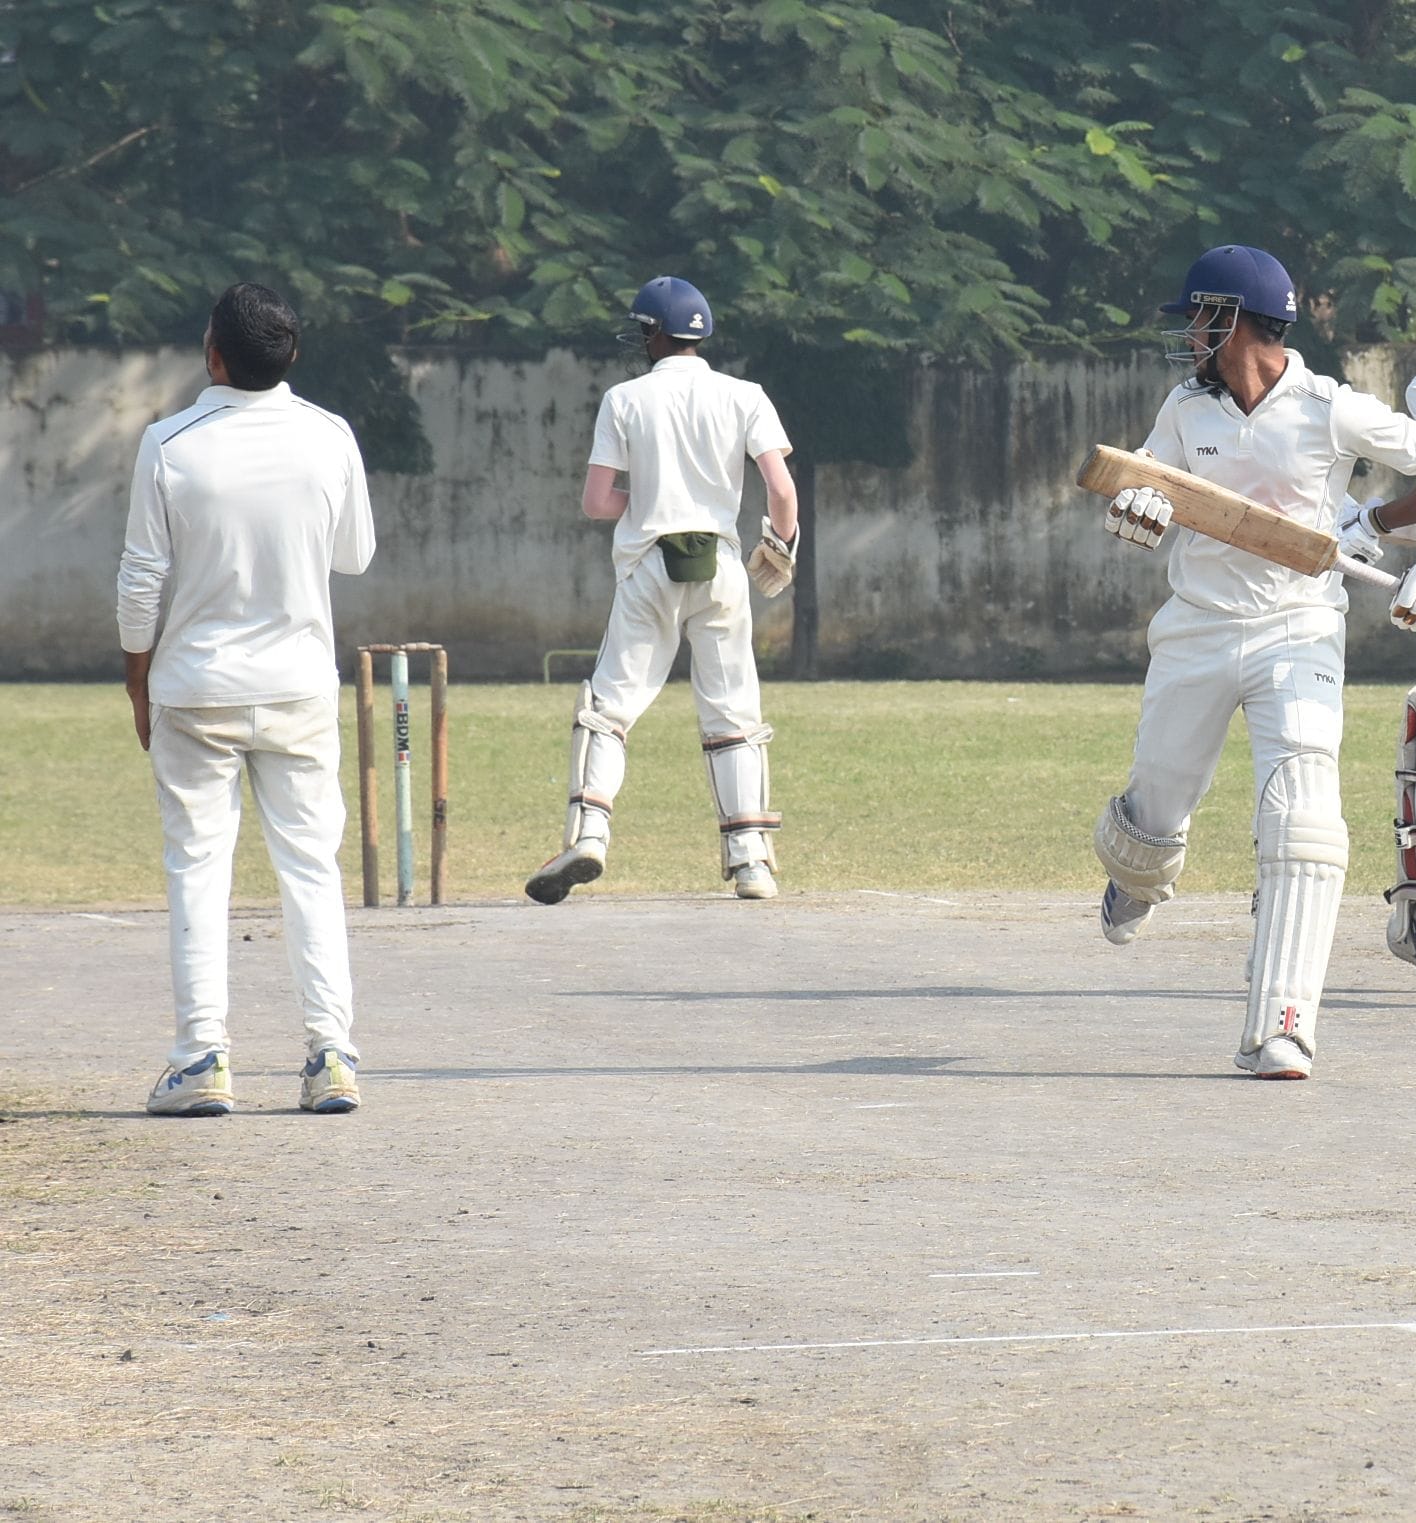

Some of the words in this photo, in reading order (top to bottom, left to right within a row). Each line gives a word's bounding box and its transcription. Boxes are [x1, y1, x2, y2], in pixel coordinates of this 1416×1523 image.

[1203, 295, 1227, 304] SHREY
[1196, 446, 1219, 456] TYKA
[1314, 672, 1336, 685] TYKA
[397, 713, 409, 751] BDM
